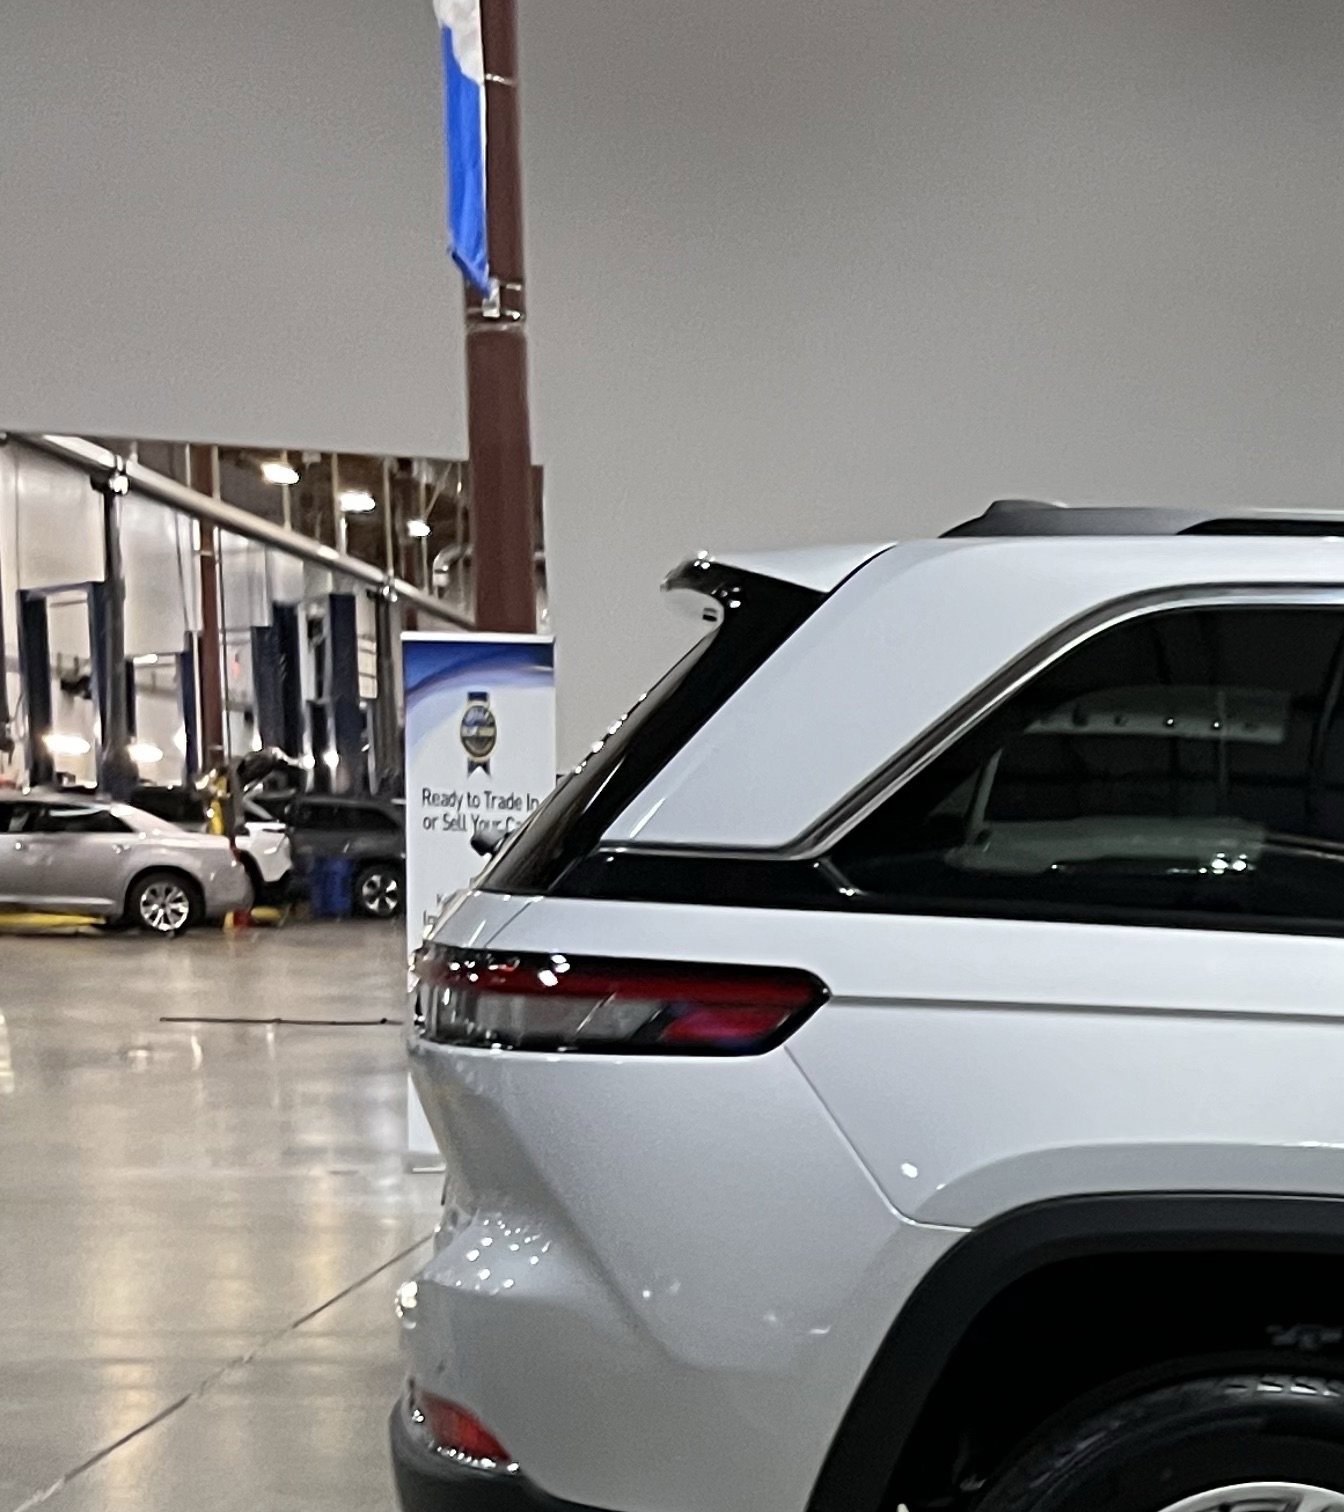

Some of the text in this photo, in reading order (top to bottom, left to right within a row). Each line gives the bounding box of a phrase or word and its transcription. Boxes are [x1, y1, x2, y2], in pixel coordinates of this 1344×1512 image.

[422, 787, 463, 812] Ready
[467, 792, 481, 809] to
[484, 790, 522, 811] Trade
[423, 816, 438, 830] or
[443, 812, 467, 832] Sell
